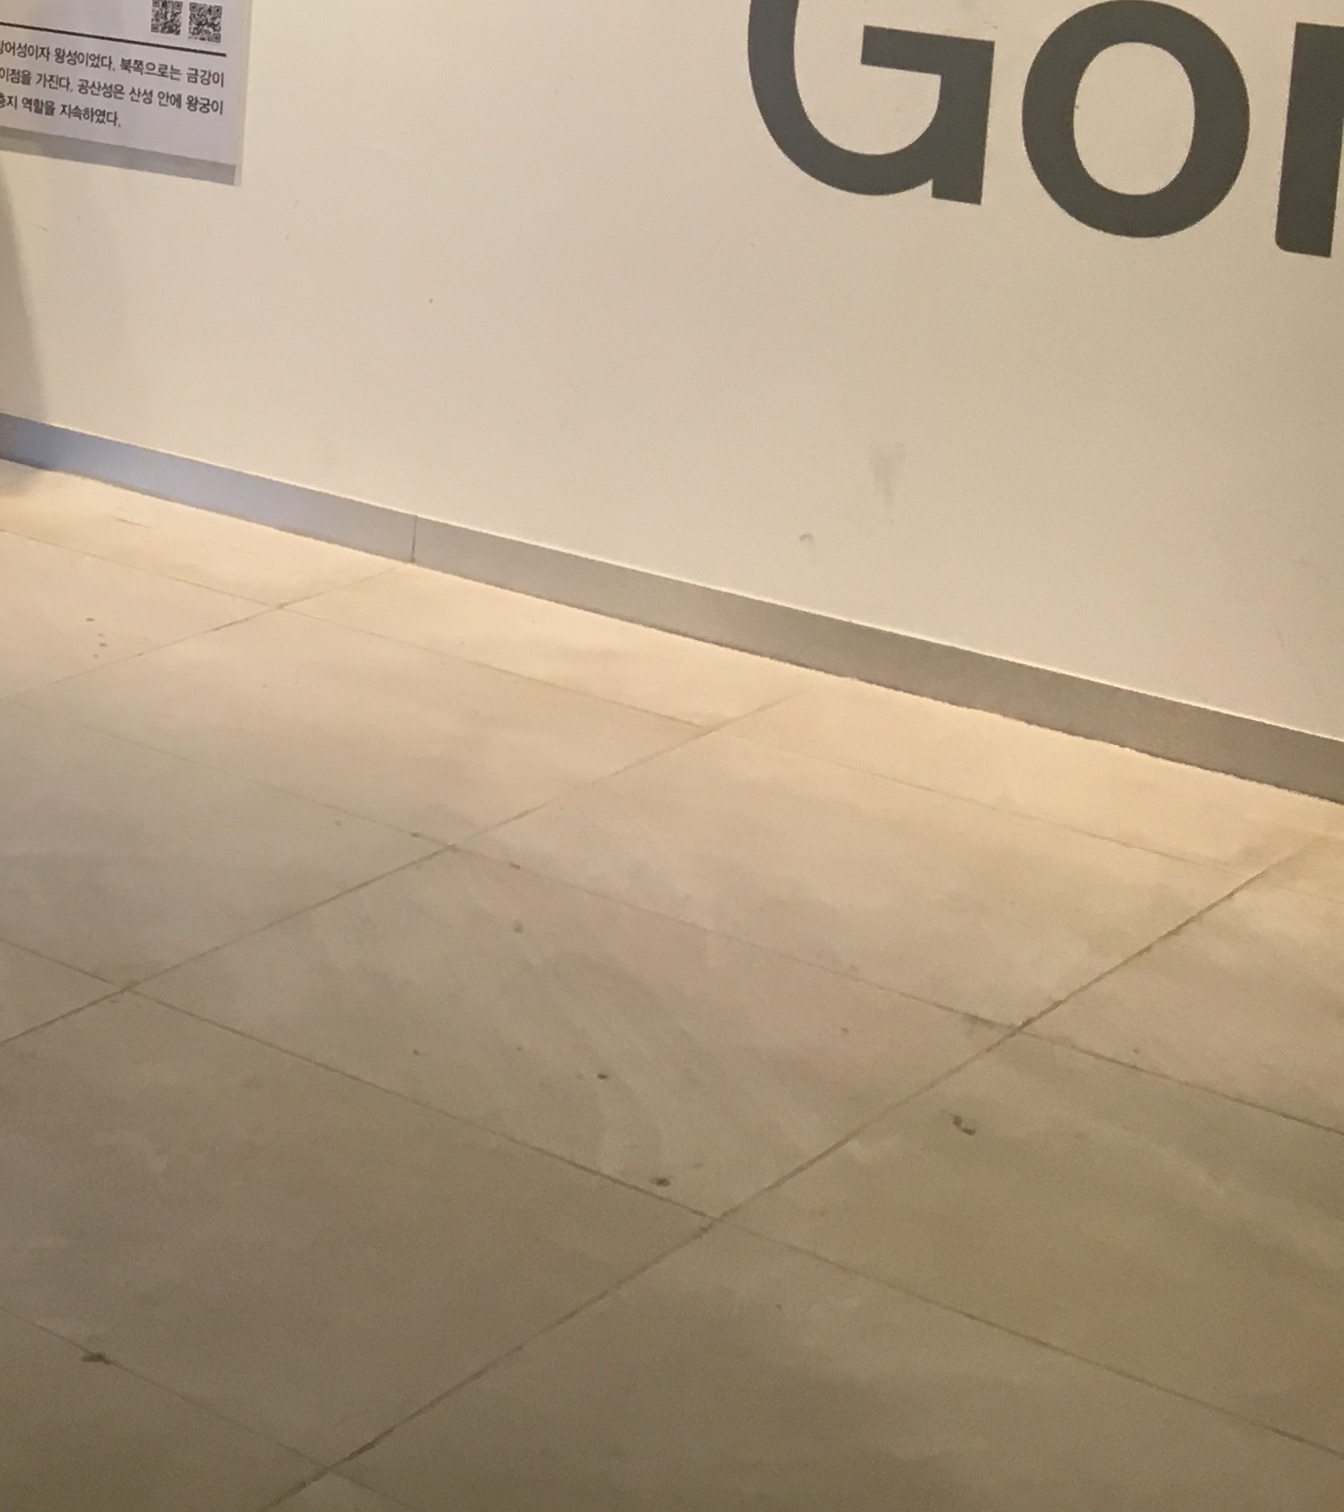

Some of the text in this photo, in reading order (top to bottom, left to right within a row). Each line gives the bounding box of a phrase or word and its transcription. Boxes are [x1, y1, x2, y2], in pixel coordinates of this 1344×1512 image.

[53, 48, 115, 71] 왕성이었다.
[119, 58, 182, 81] 북쪽으로는
[186, 68, 224, 87] 금강이
[21, 97, 56, 116] 역할을
[59, 104, 121, 127] 지속하였다.
[35, 73, 73, 92] 가진다.
[77, 79, 125, 100] 공산성은
[128, 87, 153, 104] 산성
[157, 91, 182, 109] 안에
[185, 95, 223, 115] 왕궁이
